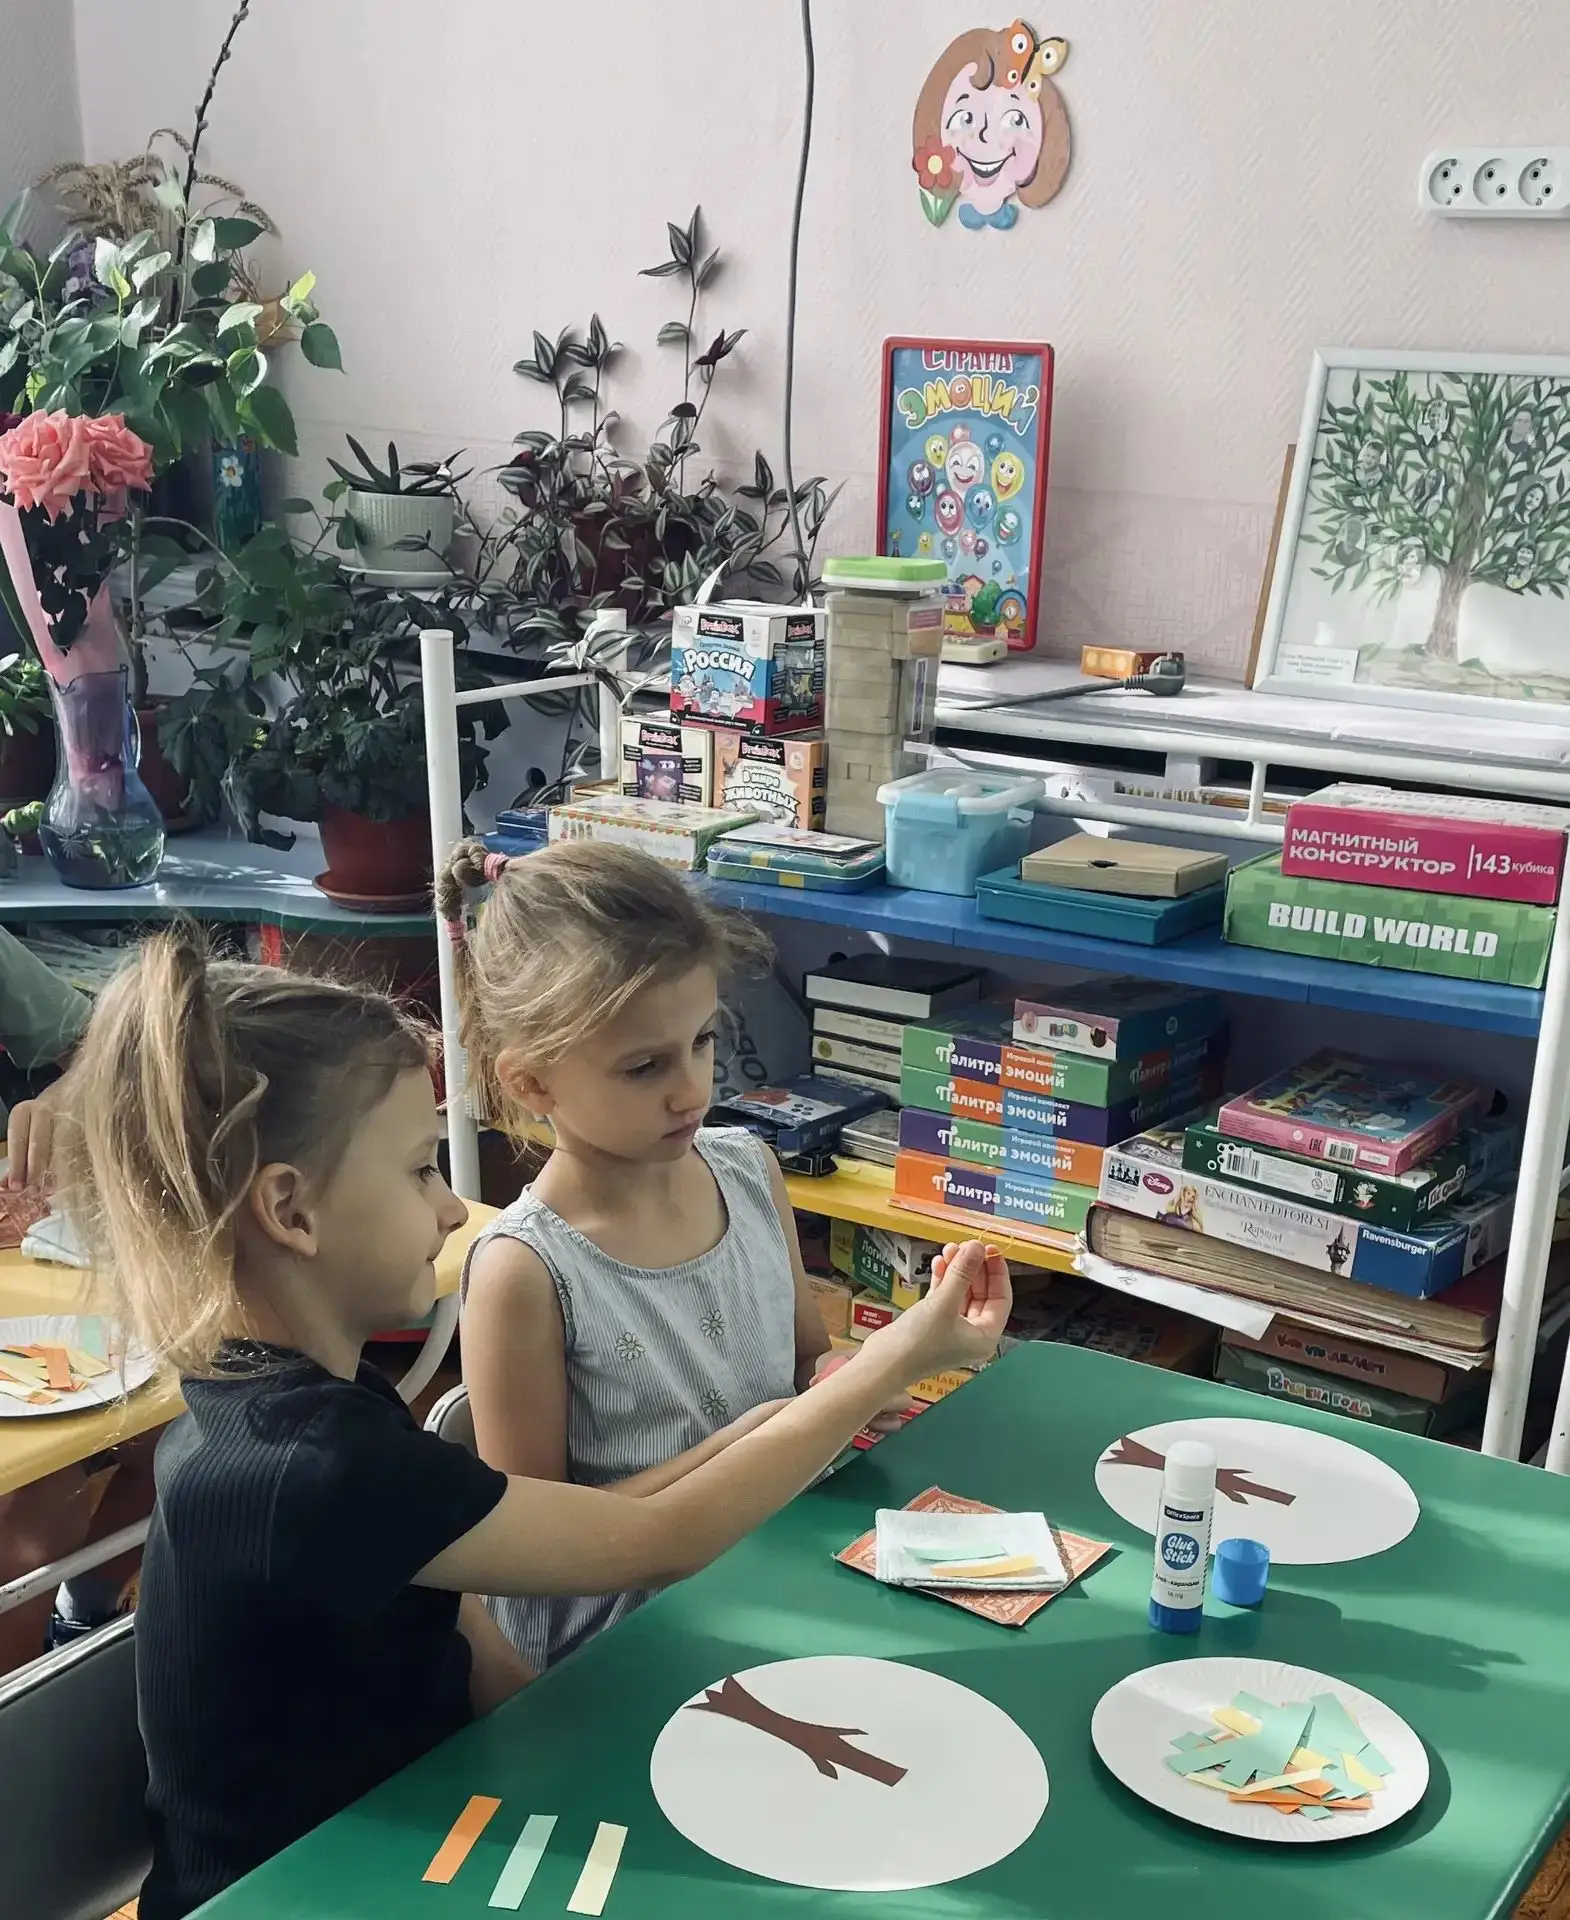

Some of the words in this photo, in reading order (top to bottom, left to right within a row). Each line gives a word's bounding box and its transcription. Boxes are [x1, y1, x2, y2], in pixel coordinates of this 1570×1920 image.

[922, 349, 1014, 374] СТРАНА
[898, 374, 1039, 436] ЭМОЦИЙ
[1291, 827, 1420, 854] МАГНИТНЫЙ
[1289, 846, 1456, 875] КОНСТРУКТОР
[1473, 852, 1511, 875] 143
[1511, 861, 1555, 876] кубика
[1268, 902, 1368, 939] BUILD
[1374, 916, 1499, 958] WORLD
[935, 1042, 1002, 1076] Палитра
[1005, 1065, 1065, 1089] эмоций
[935, 1081, 1004, 1114] Палитра
[1007, 1104, 1067, 1127] эмоций
[937, 1125, 1007, 1159] Палитра
[1010, 1148, 1072, 1171] эмоций
[932, 1171, 1001, 1206] Палитра
[1004, 1195, 1065, 1218] эмоций
[1145, 1173, 1171, 1193] Disney
[1204, 1183, 1281, 1216] ENCHANTED
[1283, 1208, 1331, 1231] FOREST
[1362, 1229, 1428, 1256] Ravensburger
[1163, 1548, 1196, 1565] Stick
[1167, 1534, 1195, 1552] Glue
